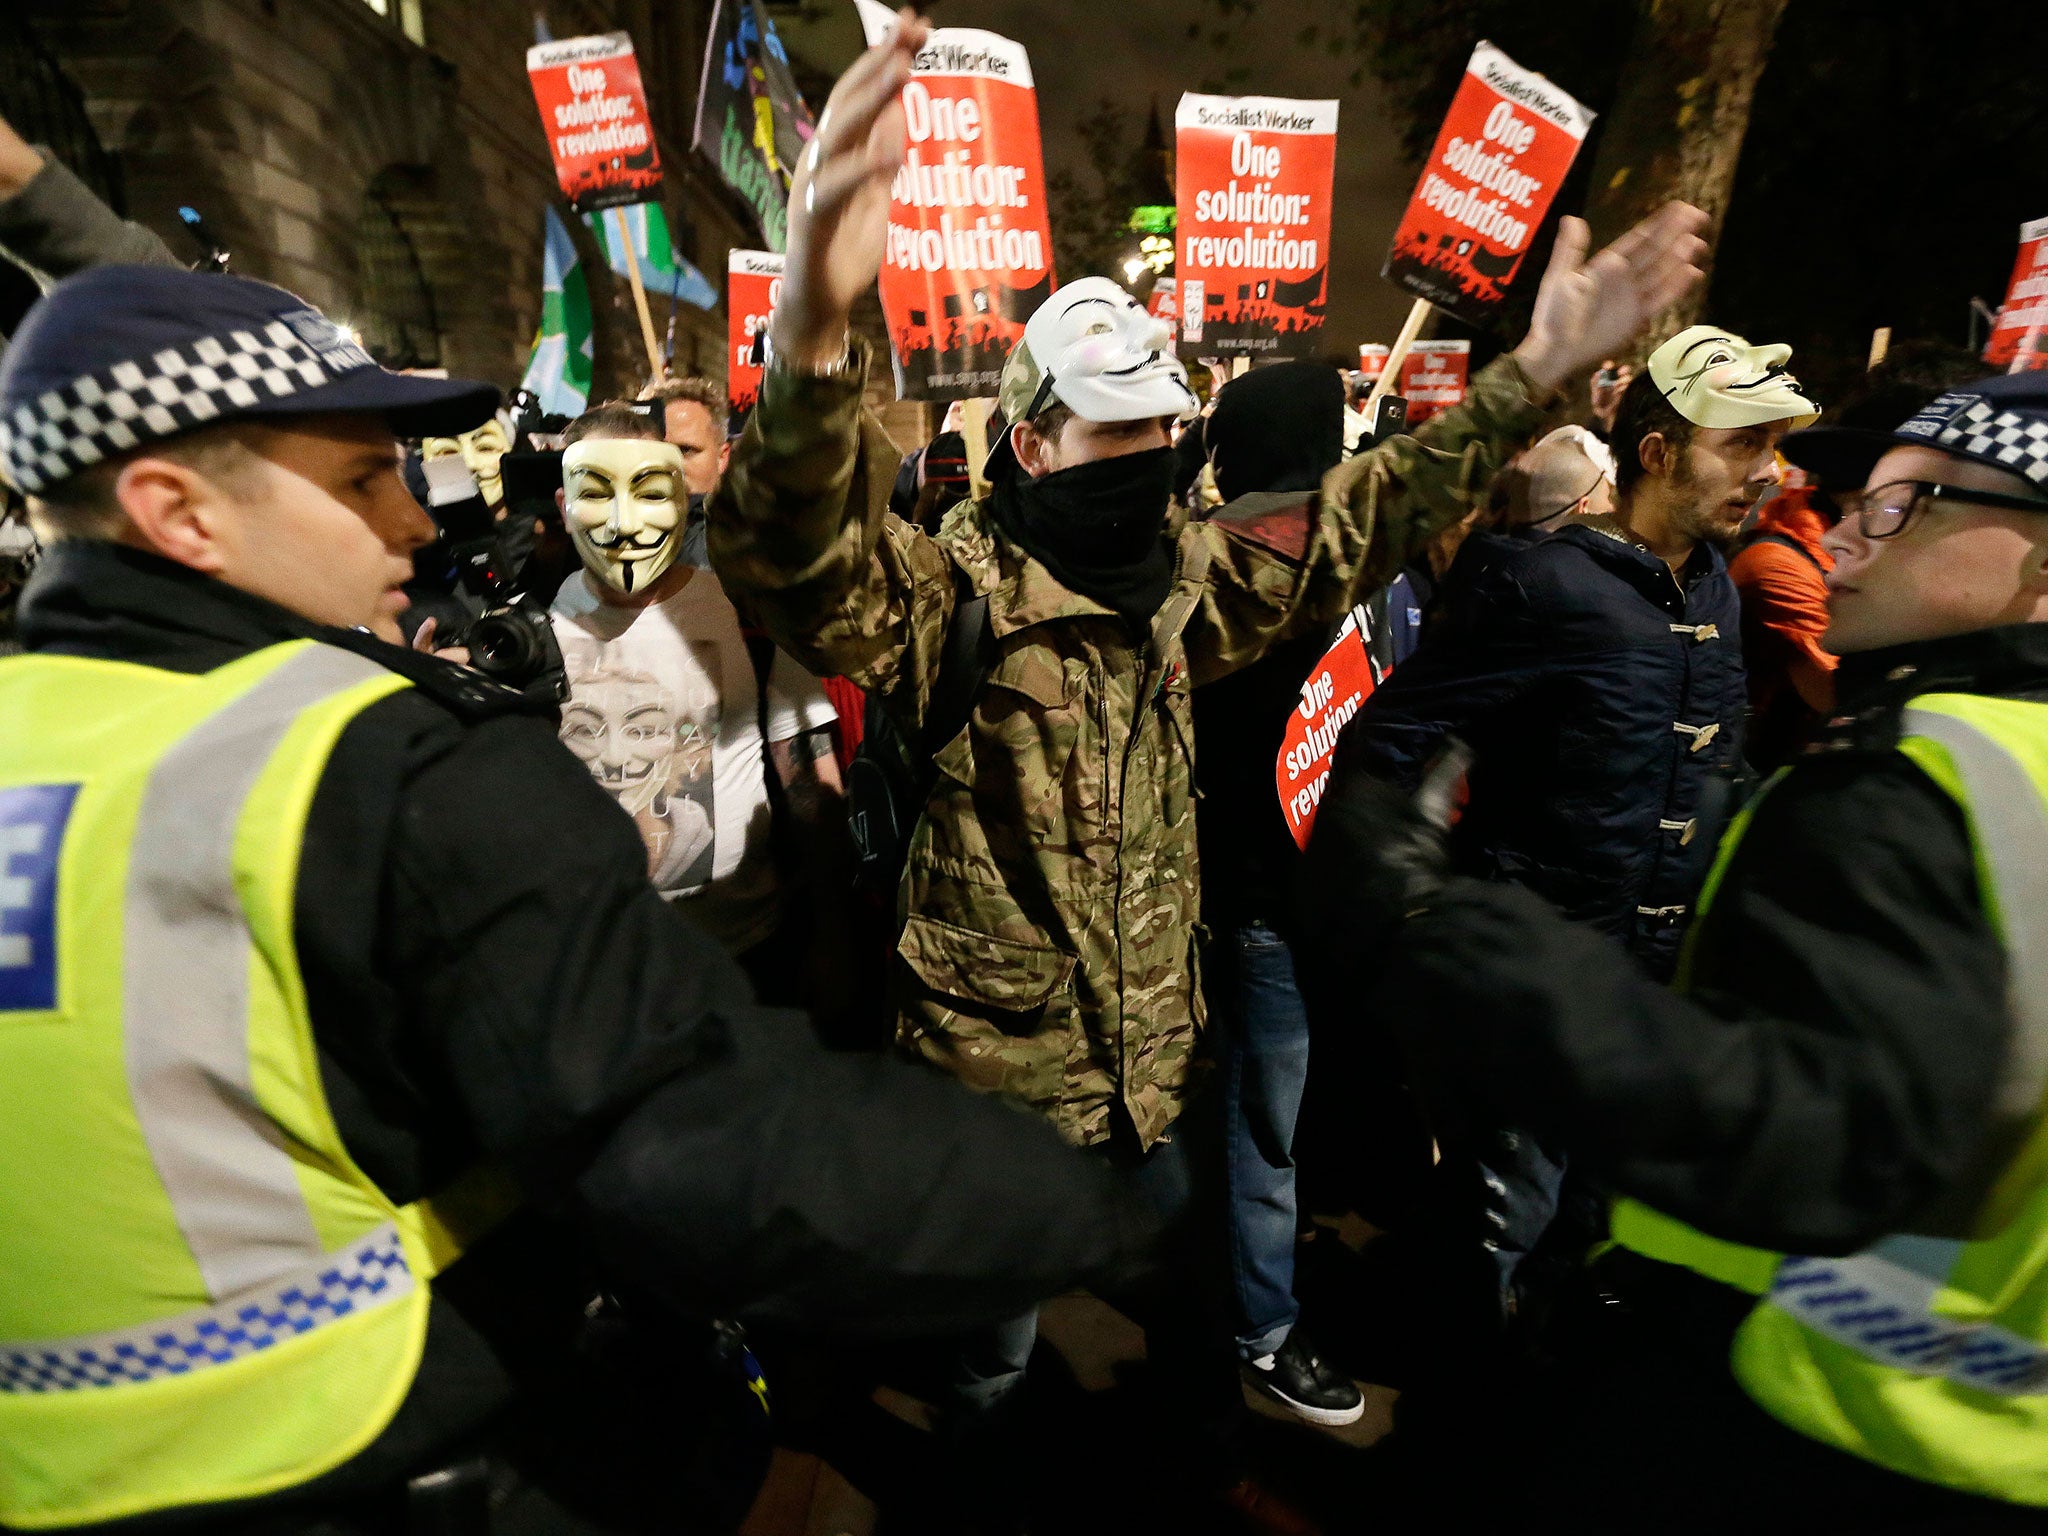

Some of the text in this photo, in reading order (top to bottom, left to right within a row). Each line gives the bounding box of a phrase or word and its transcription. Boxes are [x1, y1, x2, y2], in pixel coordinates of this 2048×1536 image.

[567, 64, 606, 95] One
[554, 92, 635, 129] solution:
[902, 81, 983, 143] One
[1483, 100, 1536, 154] One
[556, 120, 649, 158] revolution
[1231, 131, 1281, 179] One
[1442, 137, 1543, 208] solution:
[1195, 180, 1311, 226] solution:
[1418, 172, 1528, 250] revolution
[886, 213, 1045, 273] revolution
[1186, 227, 1318, 270] revolution
